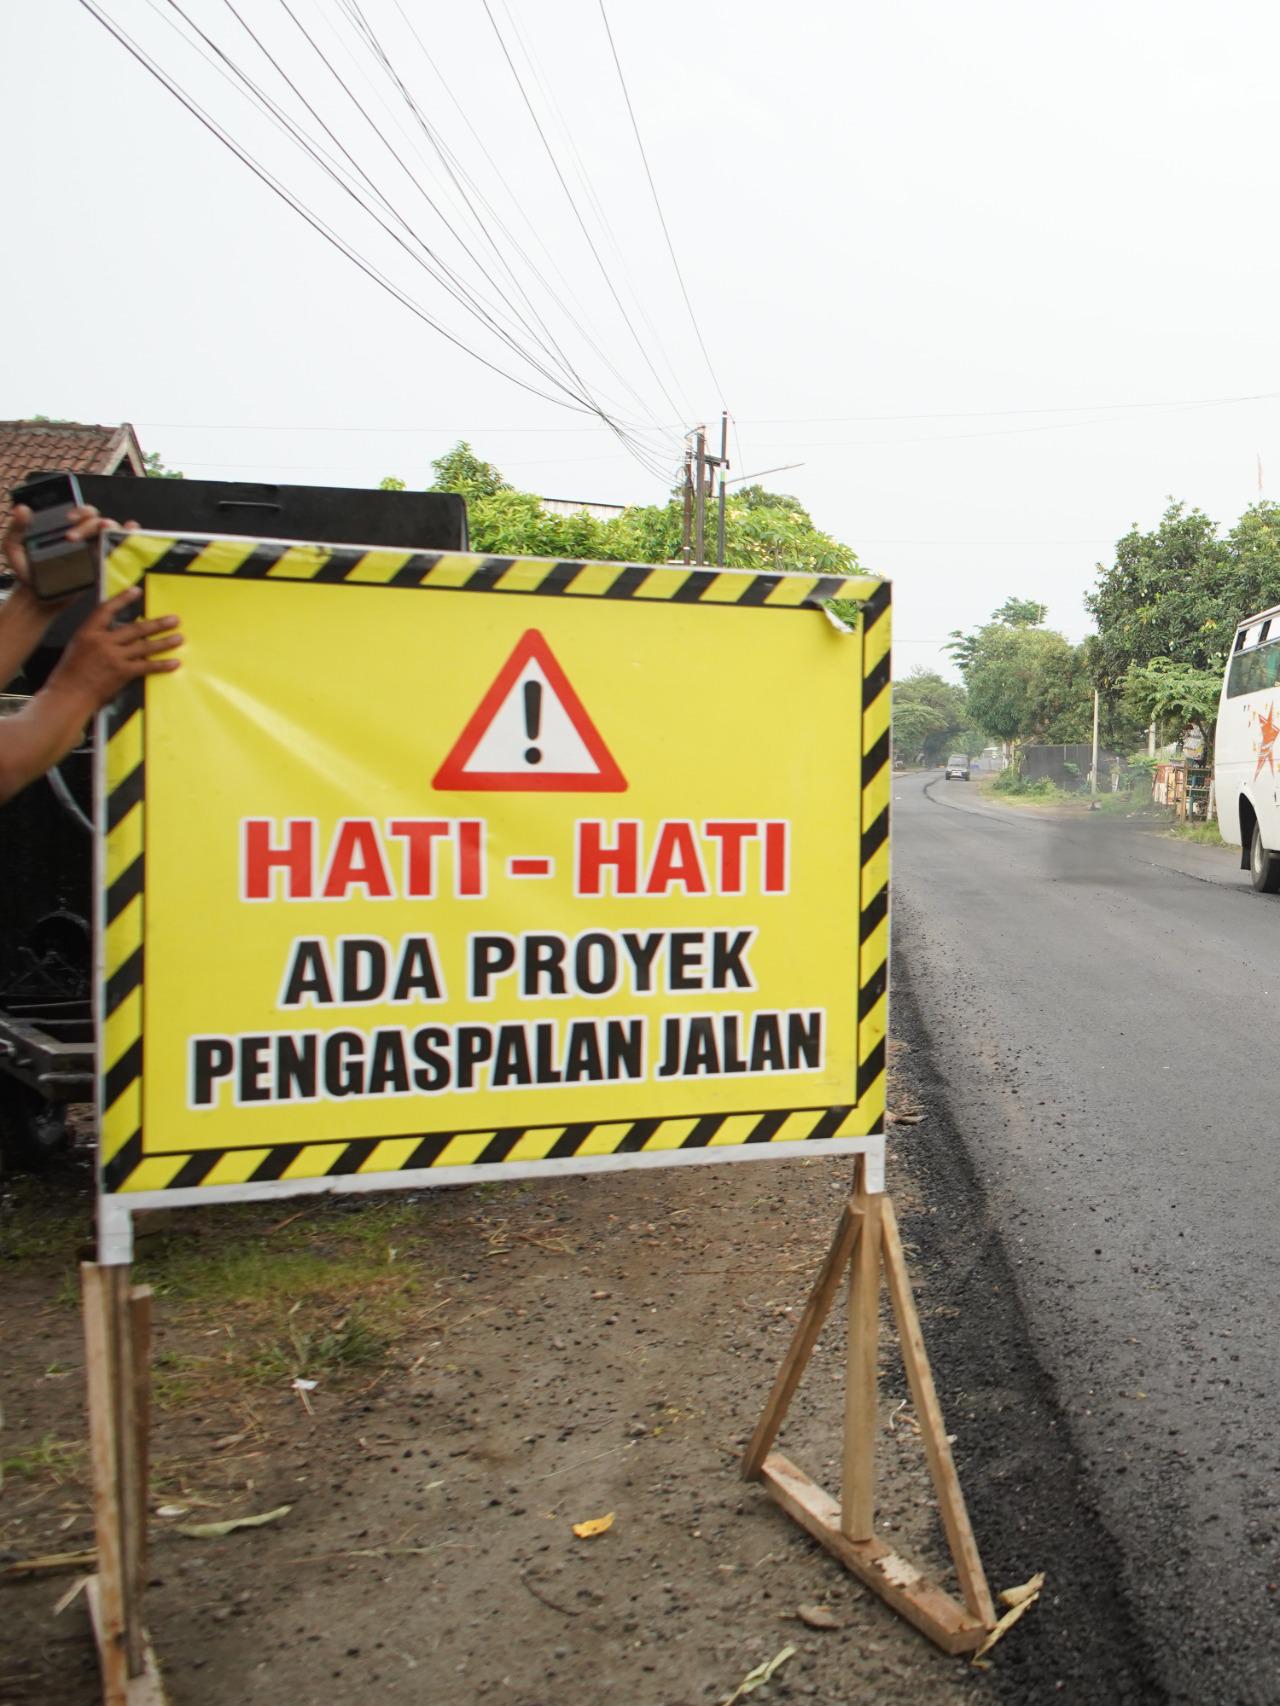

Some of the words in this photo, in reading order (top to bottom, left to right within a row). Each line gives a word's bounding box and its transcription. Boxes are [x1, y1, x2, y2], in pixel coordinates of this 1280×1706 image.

[243, 820, 485, 900] HATI
[577, 820, 787, 896] HATI
[283, 936, 442, 1005] ADA
[472, 930, 755, 998] PROYEK
[192, 1017, 643, 1105] PENGASPALAN
[659, 1009, 823, 1077] JALAN
